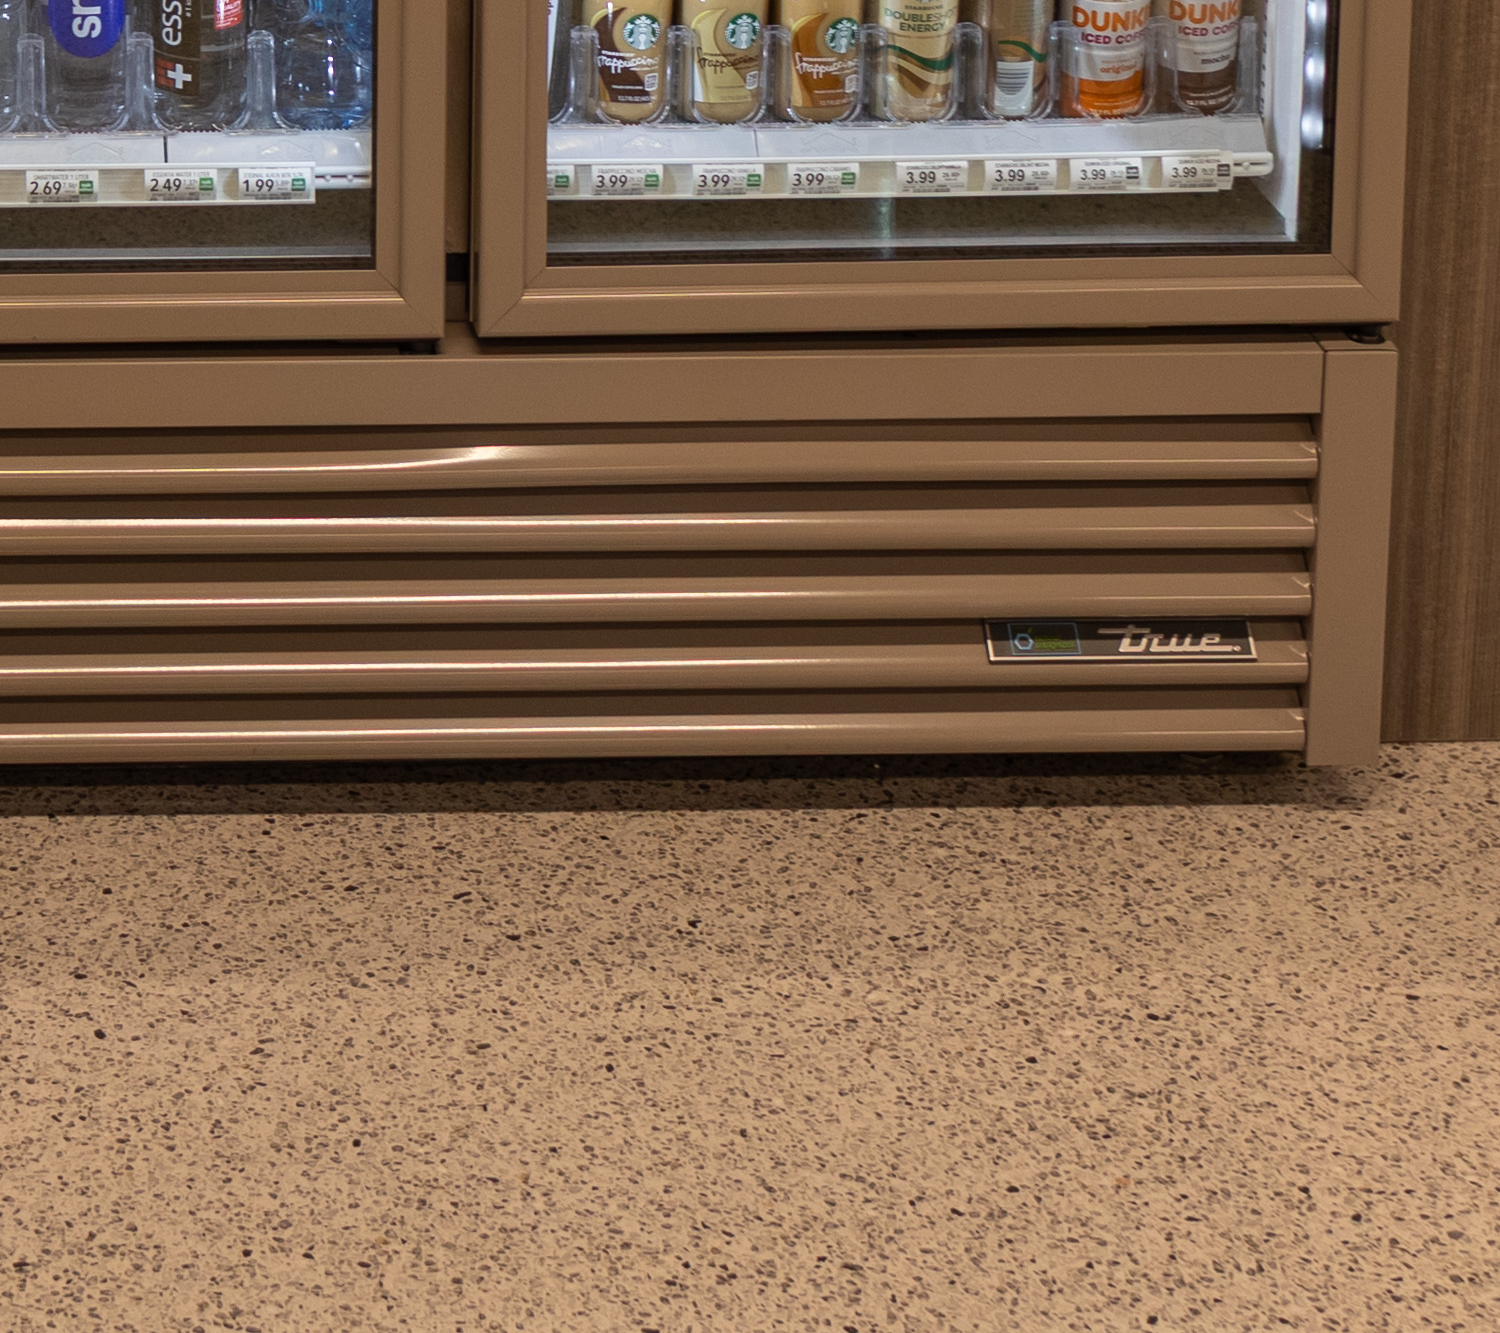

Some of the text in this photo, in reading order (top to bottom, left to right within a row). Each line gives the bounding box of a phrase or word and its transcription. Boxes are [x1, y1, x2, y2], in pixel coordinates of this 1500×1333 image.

[899, 21, 948, 33] ENERGY
[1081, 33, 1110, 44] ICED
[906, 171, 935, 184] 3.99
[1172, 167, 1197, 178] 3.99
[698, 175, 730, 187] 3.99
[30, 181, 61, 195] 2.69
